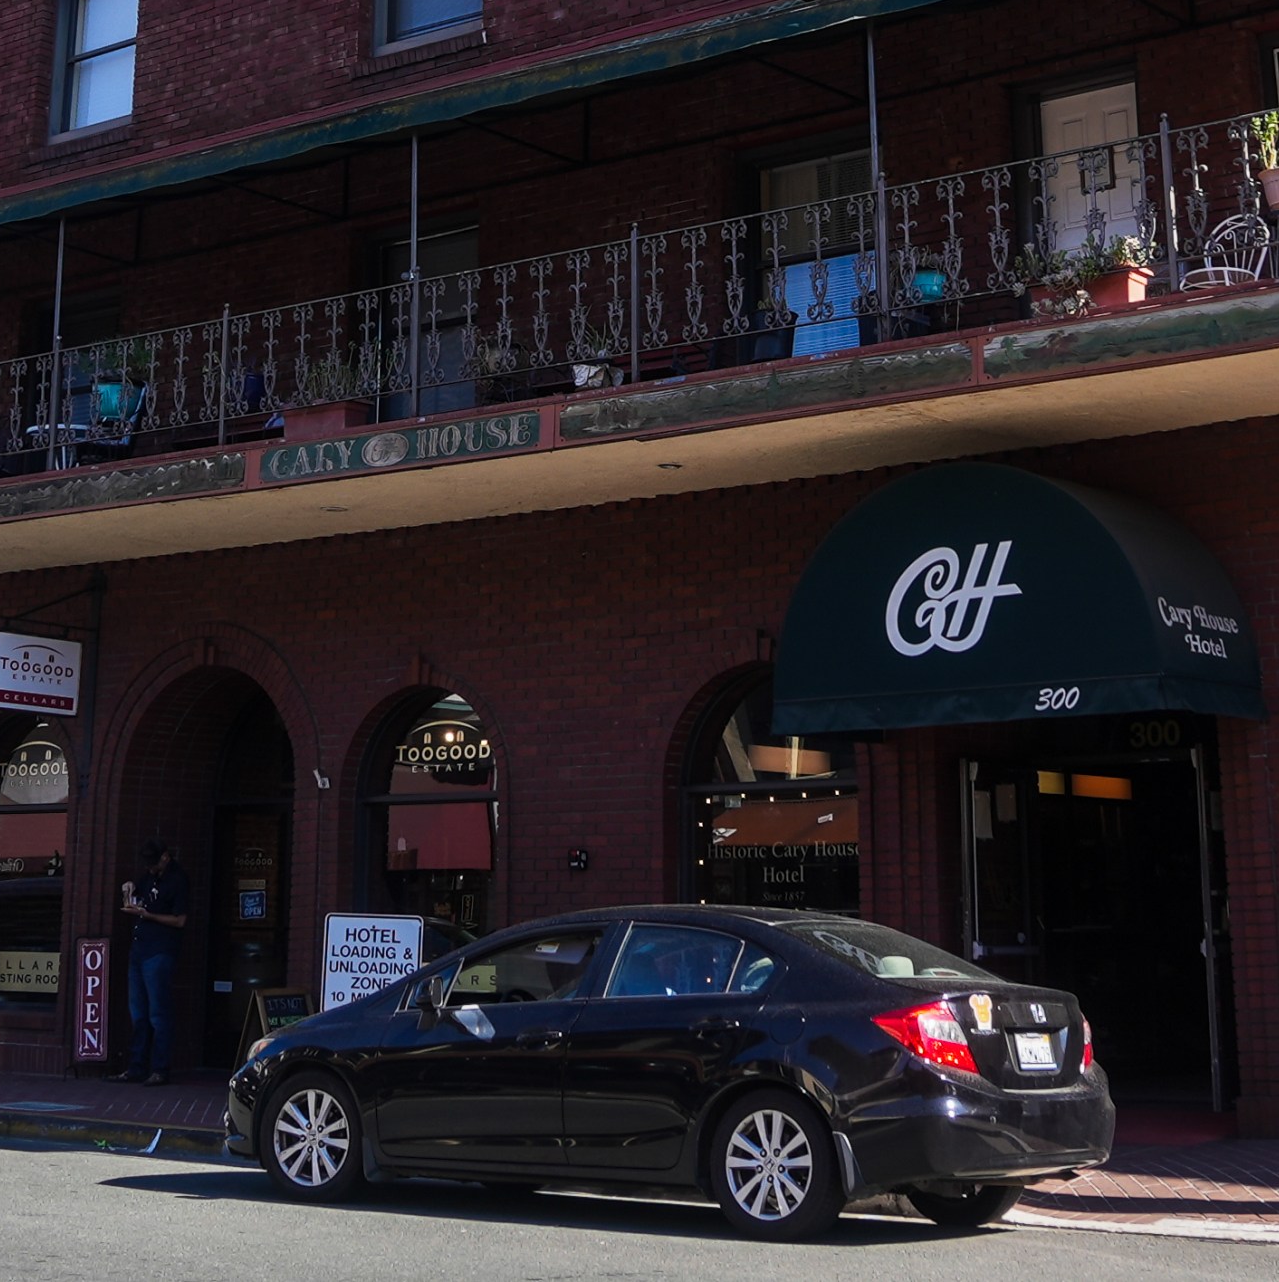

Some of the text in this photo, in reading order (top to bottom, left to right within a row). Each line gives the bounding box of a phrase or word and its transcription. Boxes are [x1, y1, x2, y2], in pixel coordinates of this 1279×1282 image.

[270, 440, 356, 479] CARY
[416, 414, 531, 460] HOUSE
[1157, 596, 1239, 634] Cary House
[1184, 633, 1227, 658] Hotel
[0, 656, 73, 677] TOOGOOD
[12, 674, 61, 685] ESTATE
[4, 693, 65, 707] CELLARS
[1034, 686, 1080, 711] 300
[1129, 719, 1181, 748] 300
[395, 744, 491, 762] TOOGOOD
[411, 762, 475, 773] ESTATE
[707, 842, 767, 858] Historic
[771, 841, 809, 863] Cary
[762, 865, 804, 883] Hotel
[345, 927, 401, 943] HOTEL
[331, 945, 413, 960] LOADING &
[329, 961, 415, 975] UNLOADING
[35, 974, 58, 984] ROO
[83, 949, 102, 1050] OPEN
[331, 991, 345, 1002] 10
